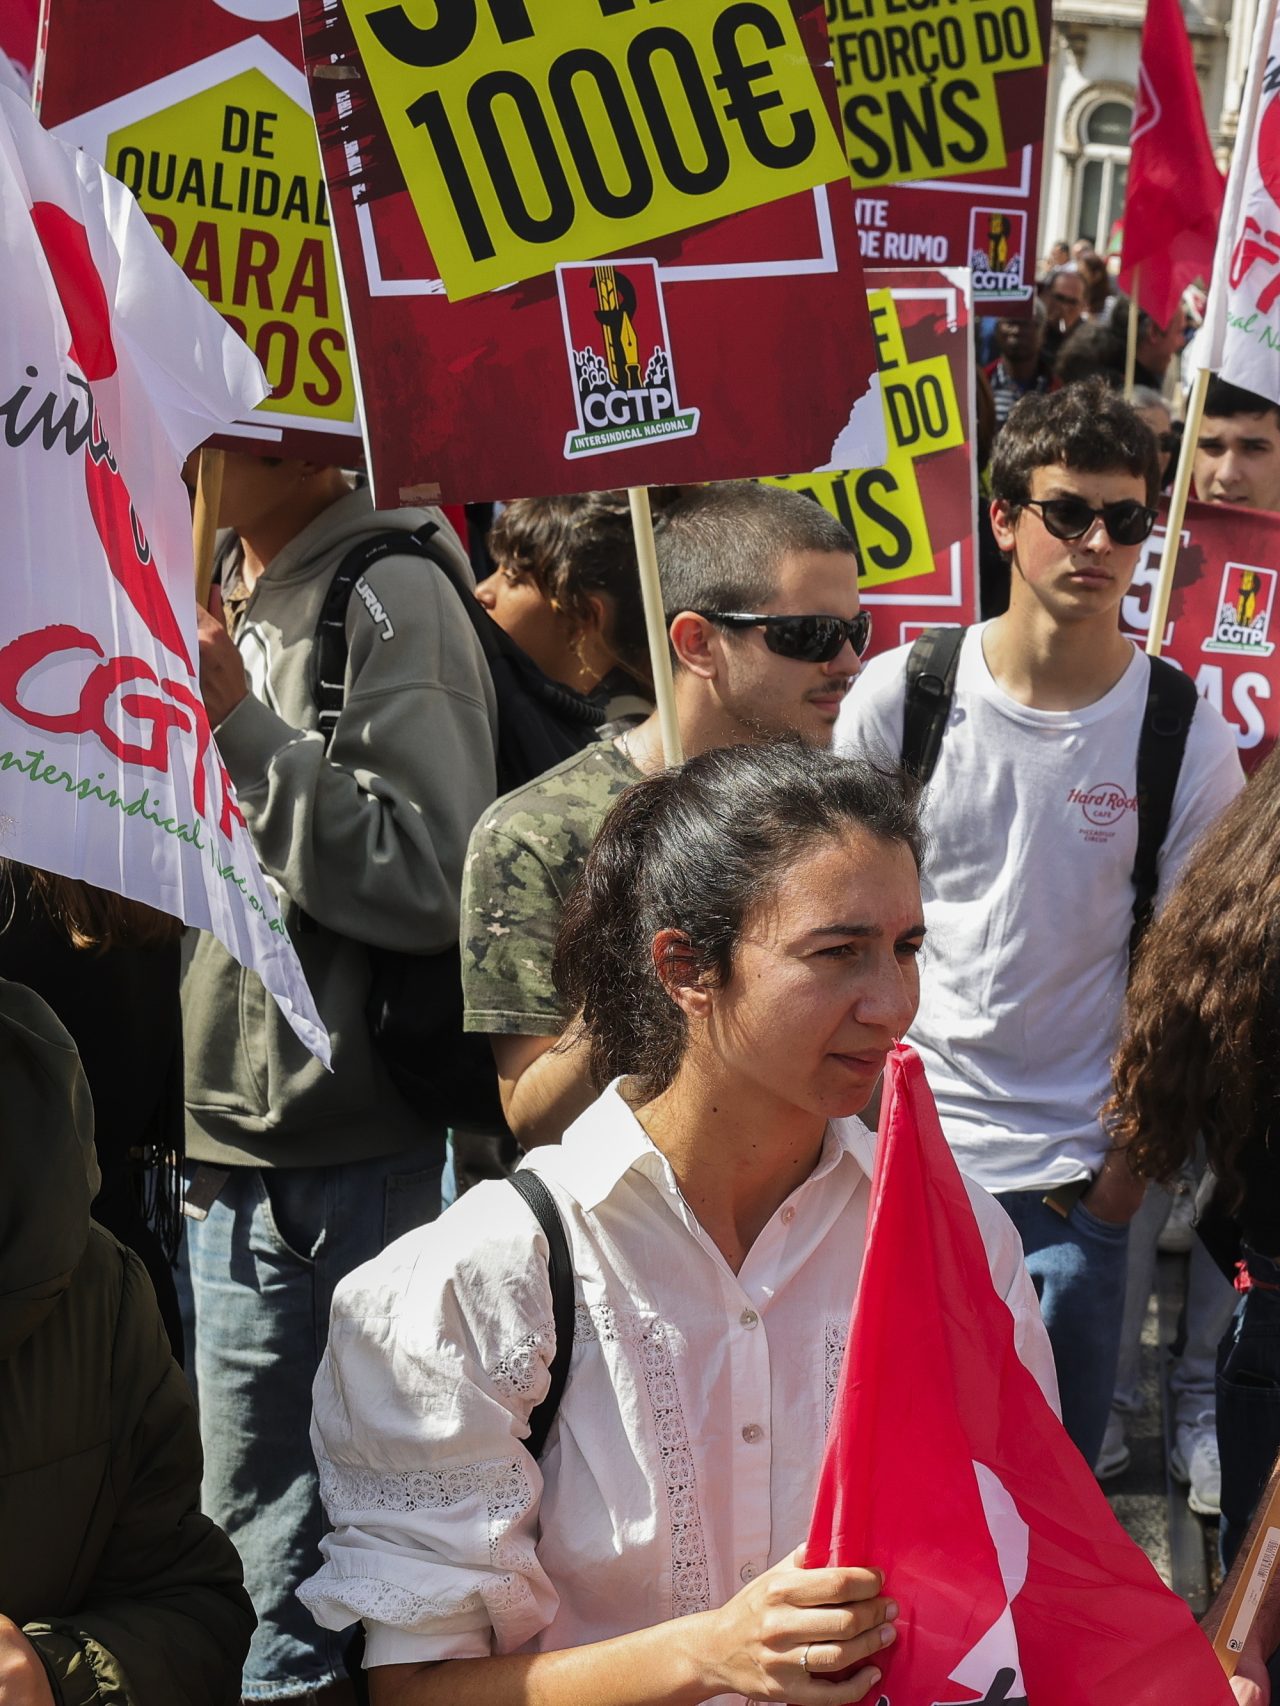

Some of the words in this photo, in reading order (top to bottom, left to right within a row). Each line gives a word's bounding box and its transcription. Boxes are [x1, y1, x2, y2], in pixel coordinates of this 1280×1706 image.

[829, 16, 967, 87] FORÇO
[974, 5, 1031, 64] DO
[221, 105, 278, 160] DE
[405, 2, 816, 263] 1000€
[843, 79, 989, 180] SNS
[884, 232, 948, 263] RUMO
[972, 270, 1020, 289] CGTP
[584, 387, 672, 428] CGTP
[884, 374, 949, 448] DO
[574, 427, 643, 449] INTERSINDICAL
[644, 418, 689, 437] NACIONAL
[1218, 623, 1263, 645] CGTP
[1067, 788, 1107, 806] Hard
